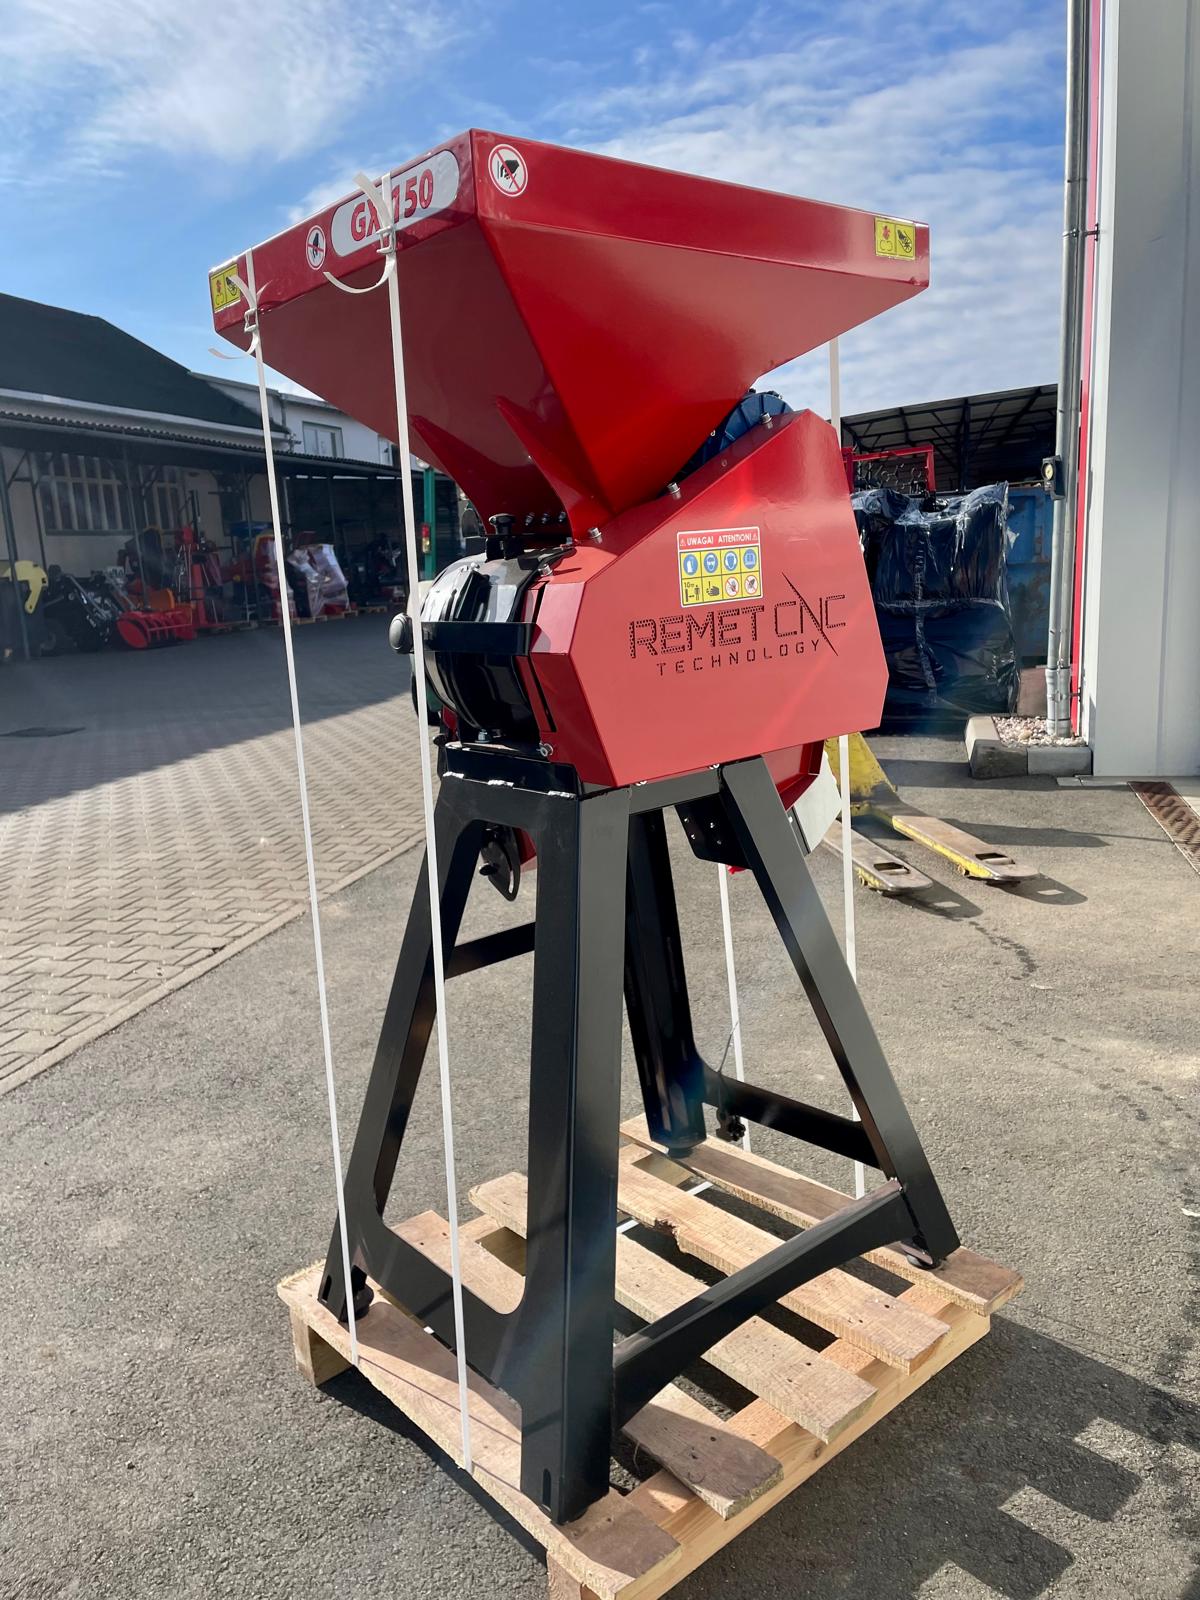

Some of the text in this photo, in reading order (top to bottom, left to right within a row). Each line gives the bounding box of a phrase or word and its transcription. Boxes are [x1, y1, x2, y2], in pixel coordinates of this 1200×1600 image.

[687, 532, 752, 546] UWAGA! ATTENTION!
[628, 572, 847, 659] REMET CNC
[656, 639, 820, 677] TECHNOLOGY
